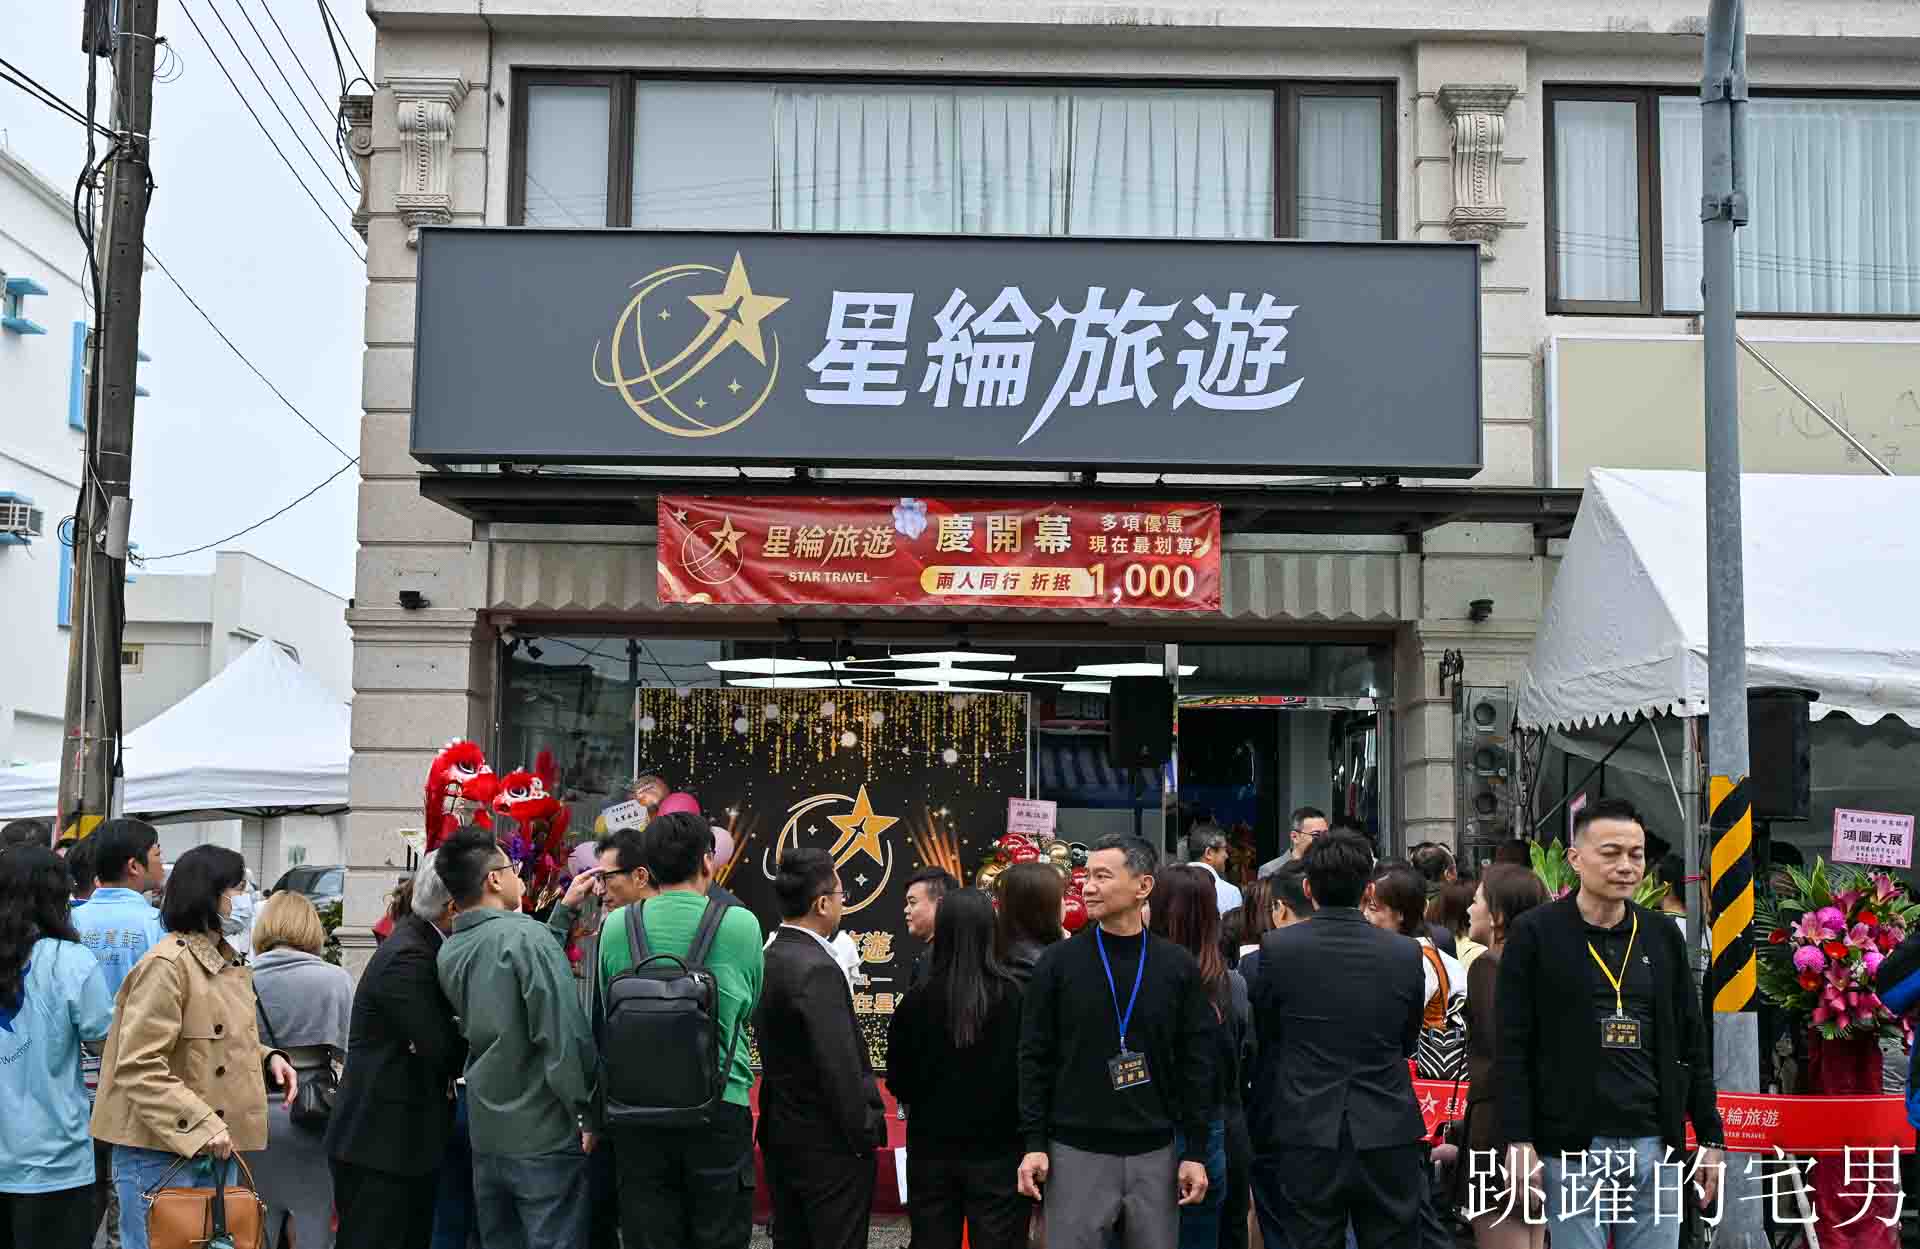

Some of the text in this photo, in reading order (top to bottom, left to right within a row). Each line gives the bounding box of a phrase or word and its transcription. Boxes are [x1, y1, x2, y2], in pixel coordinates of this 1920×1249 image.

[805, 287, 1304, 445] 星綸旅遊
[935, 514, 1072, 555] 慶開幕
[1101, 513, 1183, 533] 多項優惠
[761, 524, 897, 567] 星綸旅遊
[1088, 535, 1195, 555] 現在最划算
[788, 571, 871, 583] STAR TRAVEL
[936, 572, 1072, 592] 兩人同行 折抵
[1087, 562, 1195, 603] 1,000
[853, 991, 904, 1014] 在星
